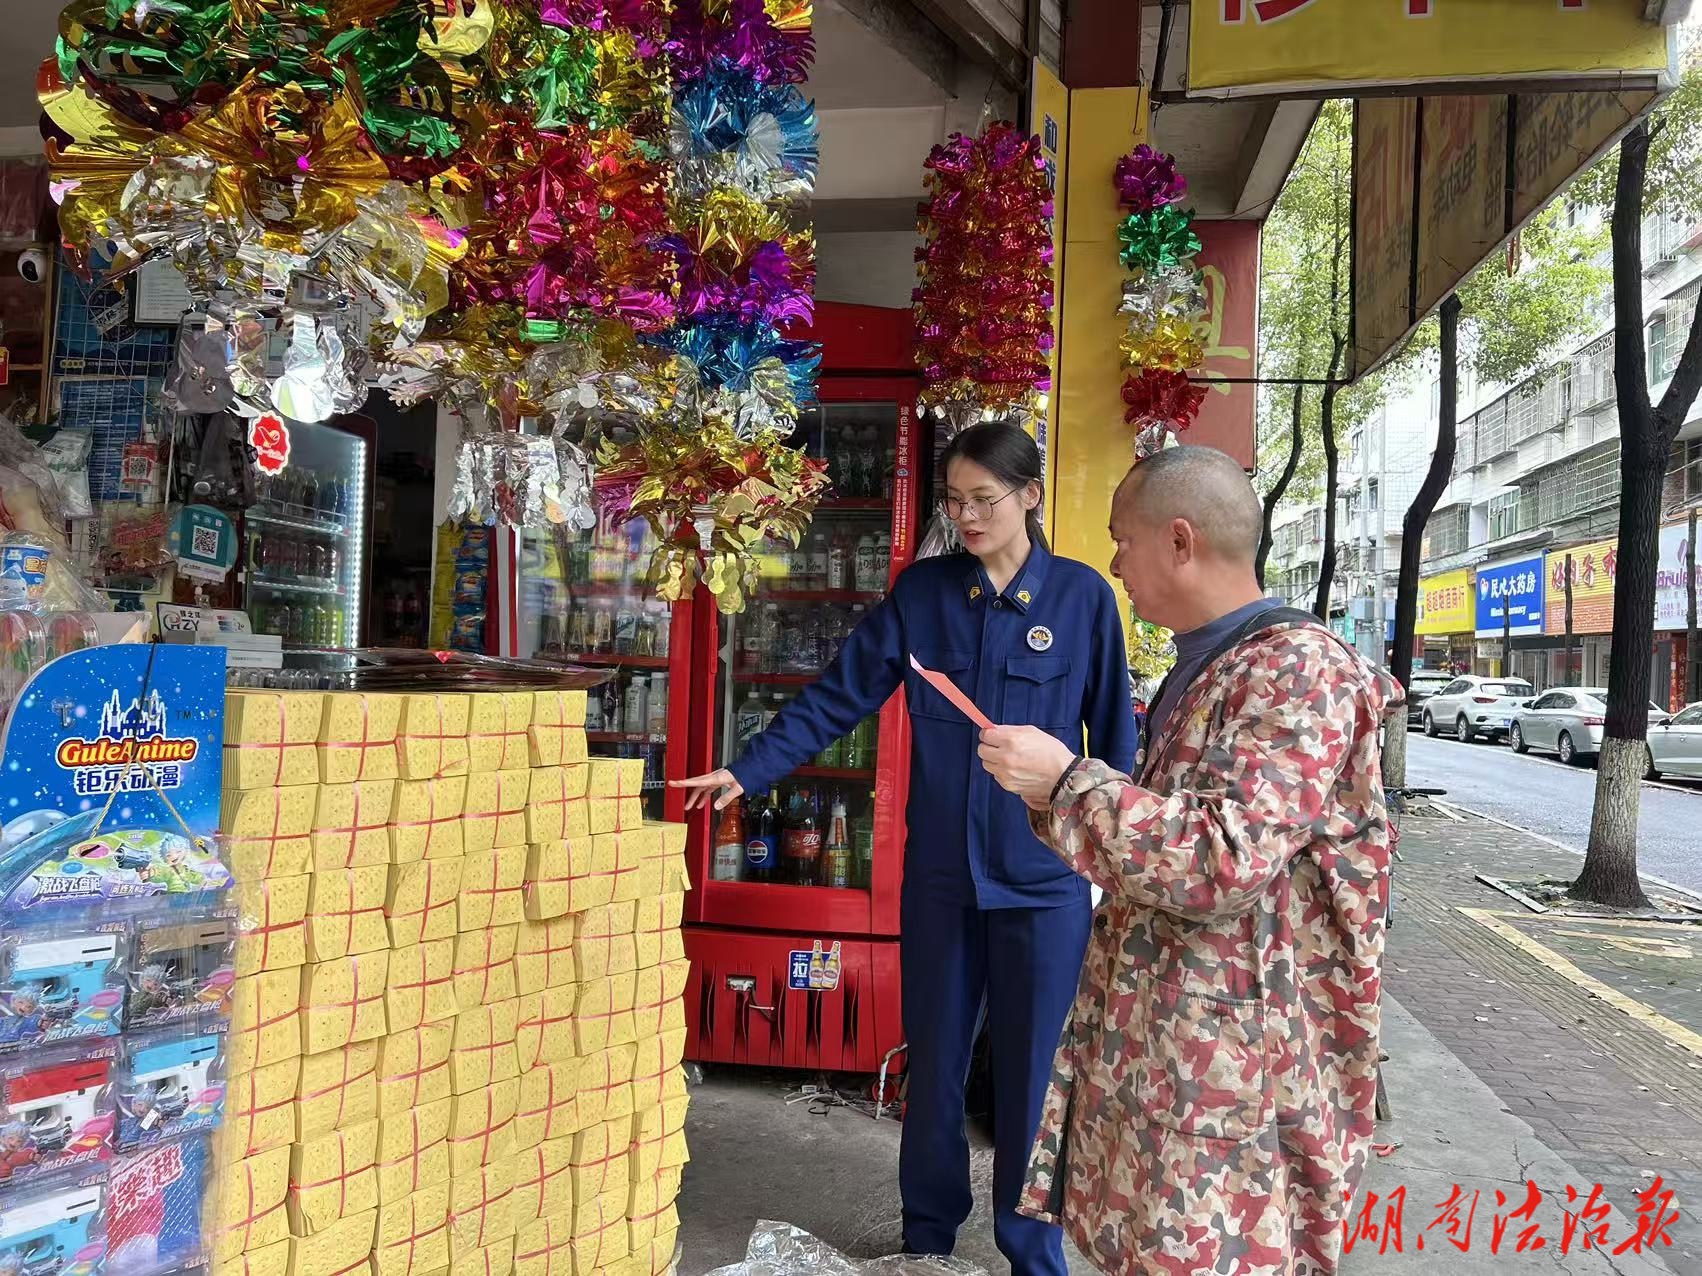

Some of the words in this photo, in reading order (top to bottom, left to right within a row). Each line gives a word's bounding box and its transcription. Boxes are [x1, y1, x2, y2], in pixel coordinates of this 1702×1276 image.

[1490, 570, 1537, 599] 民心大药房
[175, 710, 193, 721] TM
[60, 738, 194, 765] GuleAnime
[76, 765, 179, 793] 钜乐动漫
[793, 962, 808, 978] 拉
